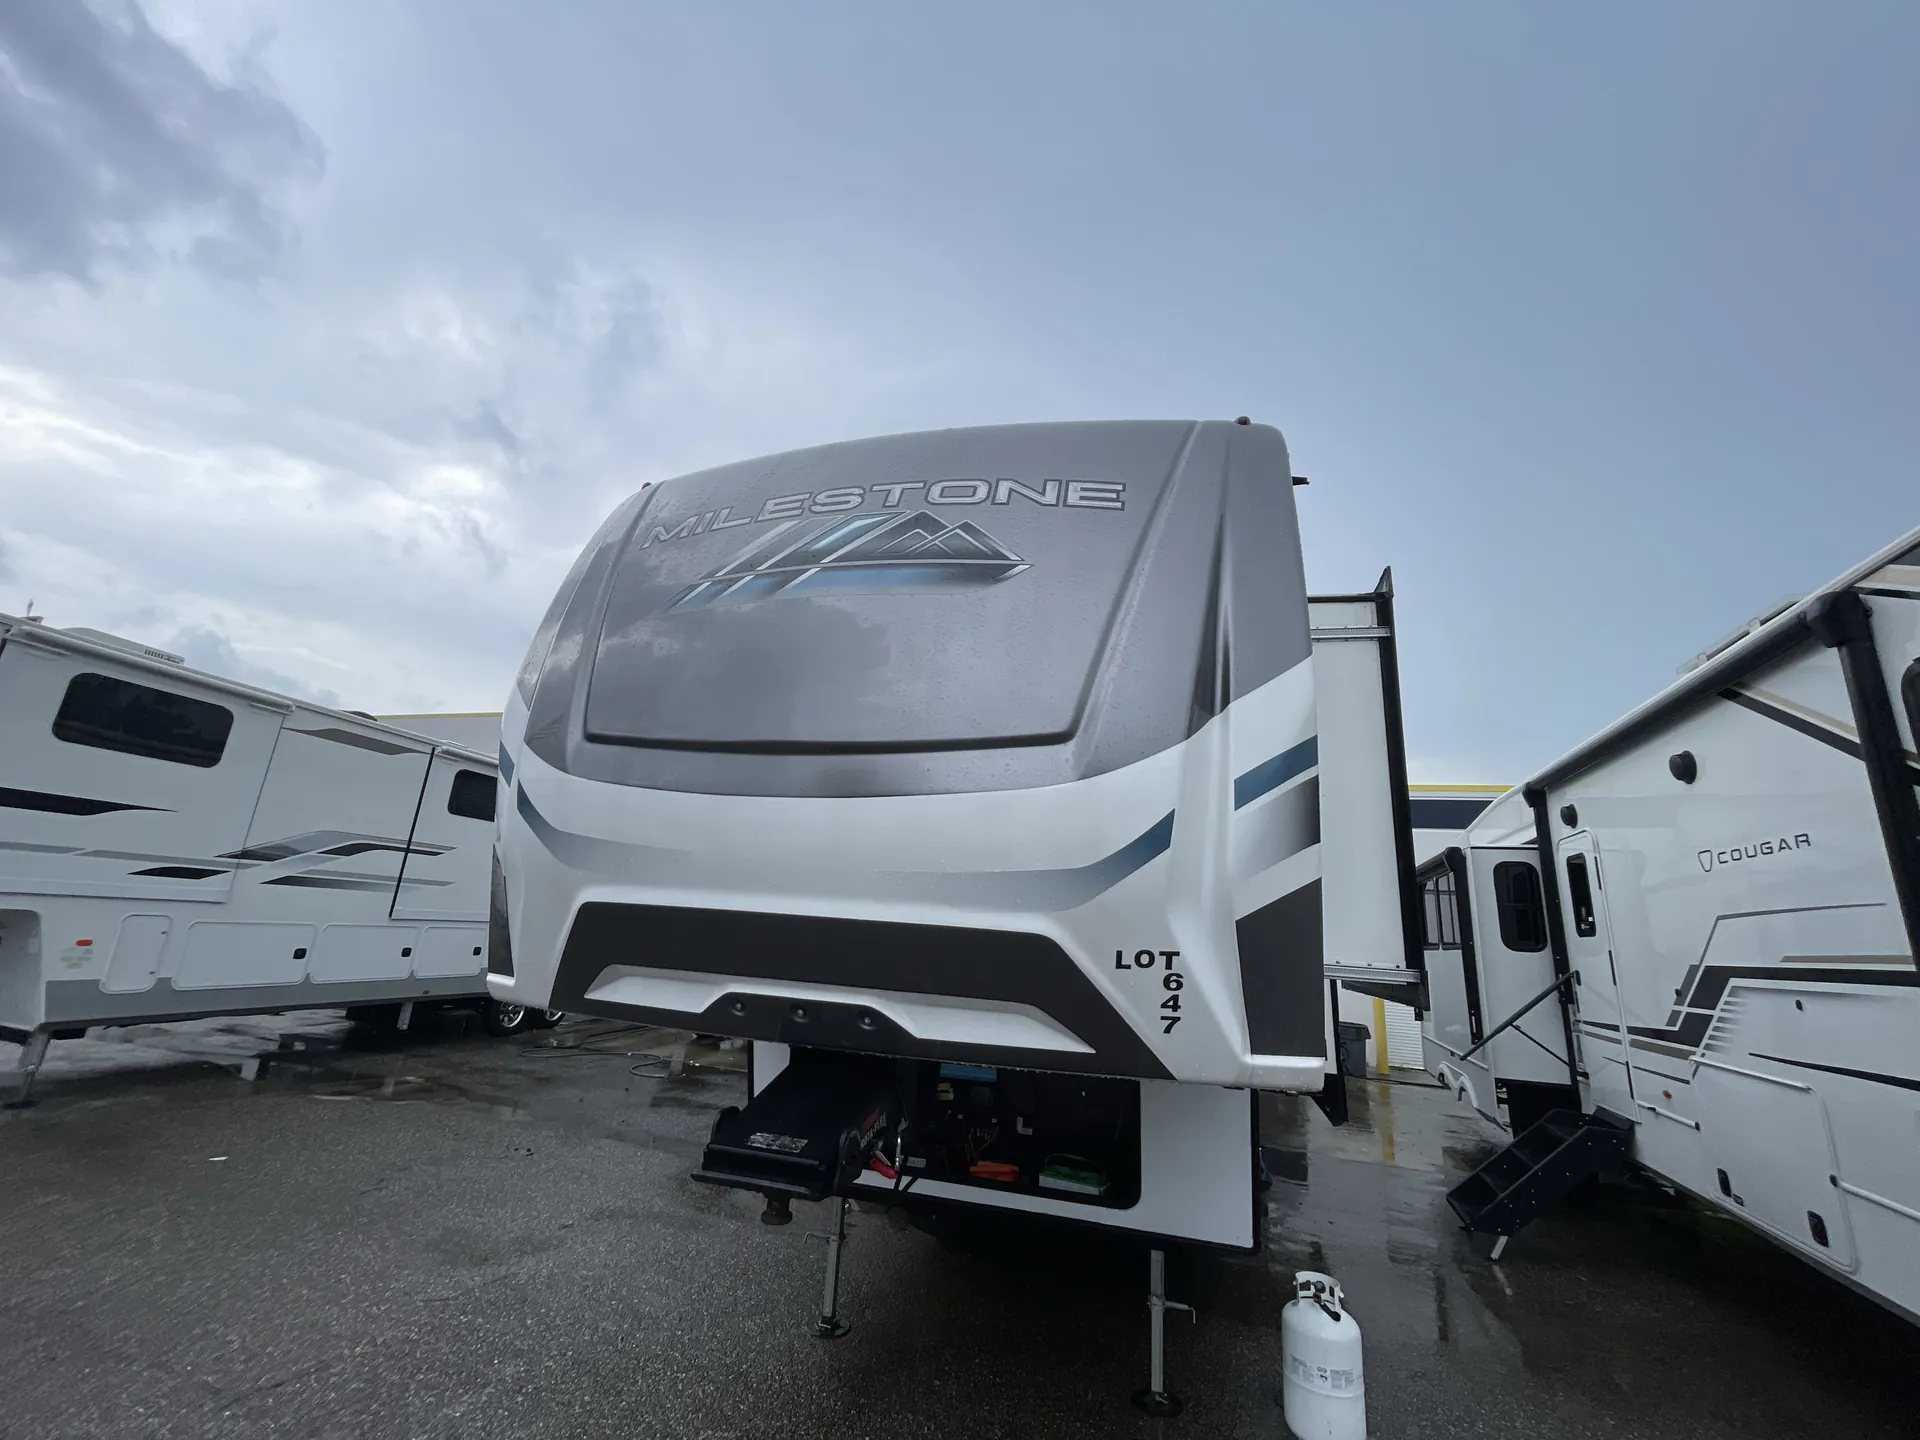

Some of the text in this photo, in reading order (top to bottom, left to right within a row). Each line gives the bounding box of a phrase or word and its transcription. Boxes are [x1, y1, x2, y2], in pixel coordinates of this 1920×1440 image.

[640, 478, 1126, 550] MILESTONE
[1717, 833, 1811, 864] COUGAR
[1115, 949, 1180, 970] LOT
[1160, 972, 1184, 1034] 647
